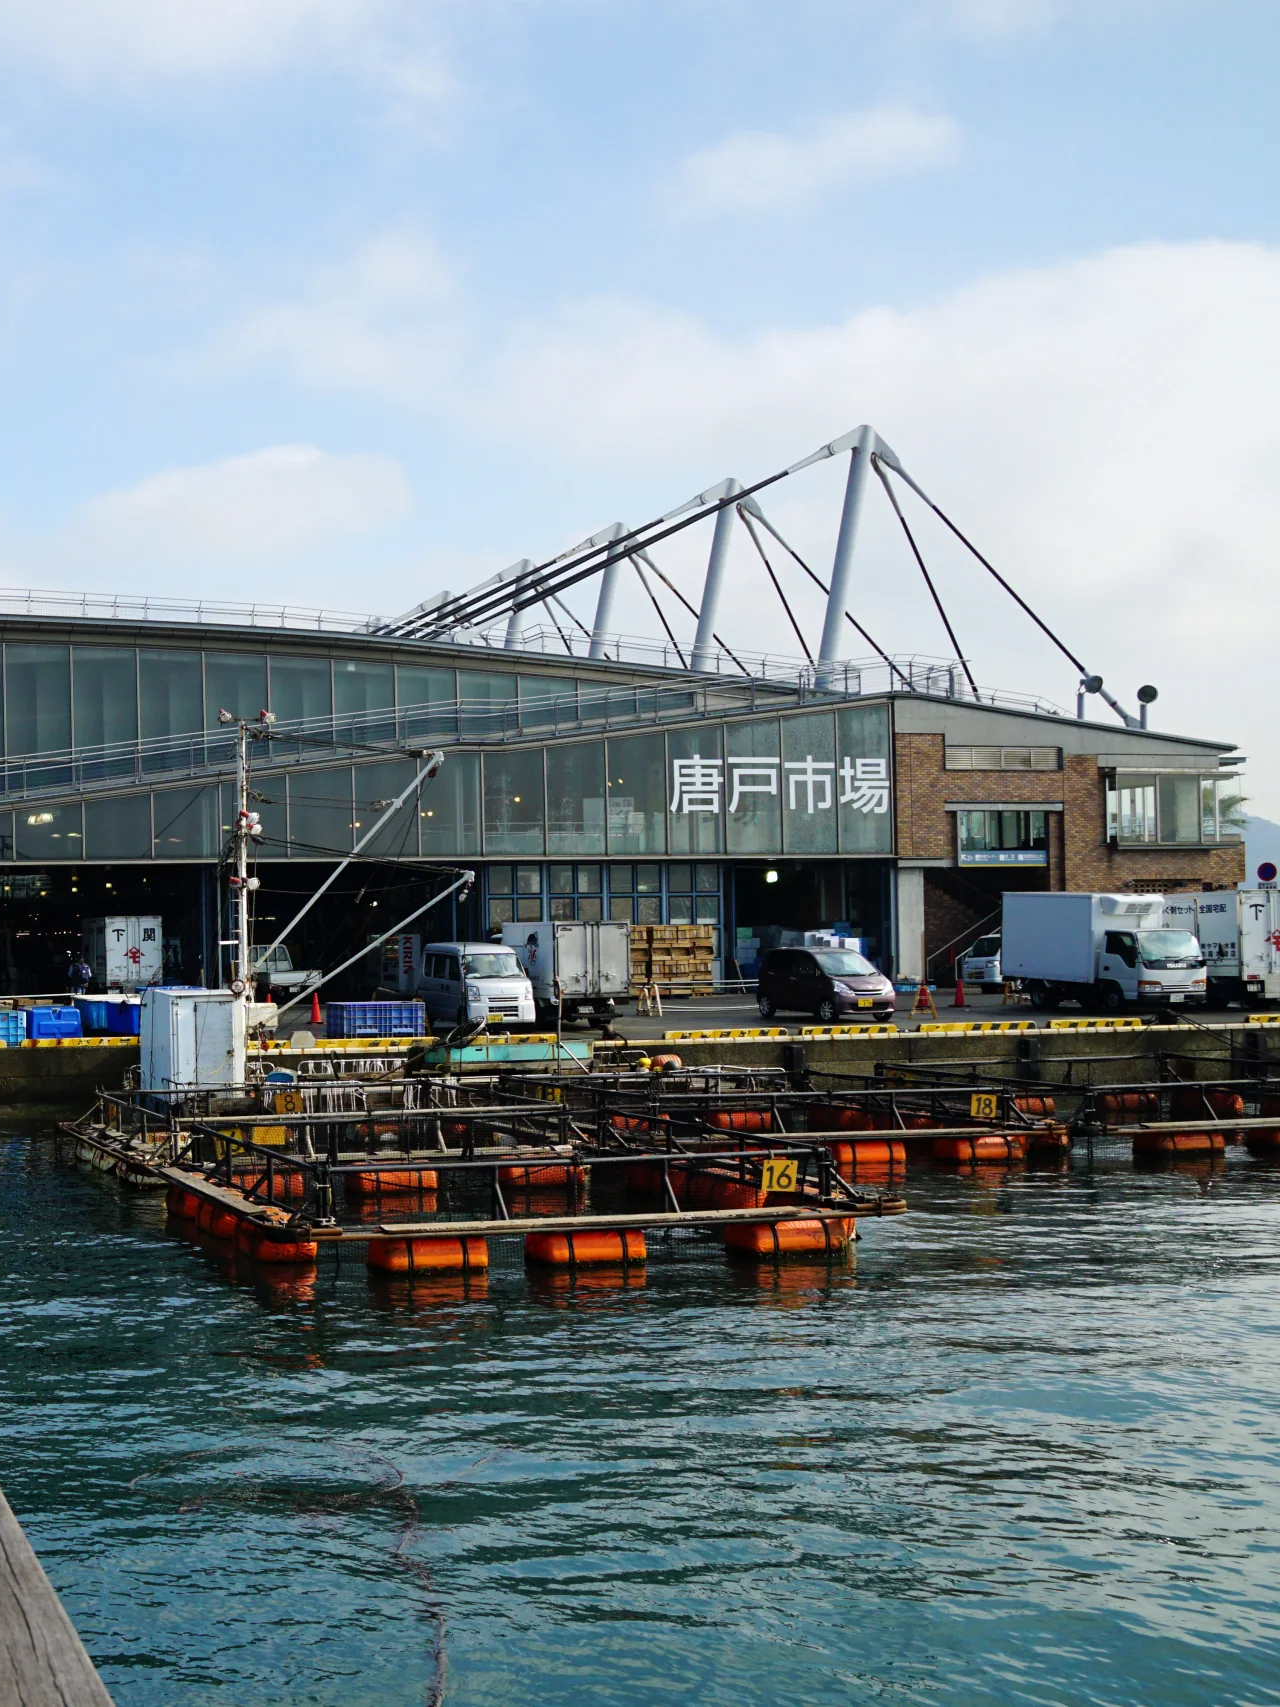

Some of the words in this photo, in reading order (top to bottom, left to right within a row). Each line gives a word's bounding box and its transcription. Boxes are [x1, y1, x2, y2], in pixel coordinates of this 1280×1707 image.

[670, 754, 890, 814] 唐戸市場
[1199, 904, 1227, 914] 全国宅配
[1249, 903, 1265, 921] 下
[403, 936, 413, 975] KIRIN
[284, 1094, 296, 1111] 8
[975, 1096, 993, 1116] 18
[766, 1164, 793, 1189] 16
